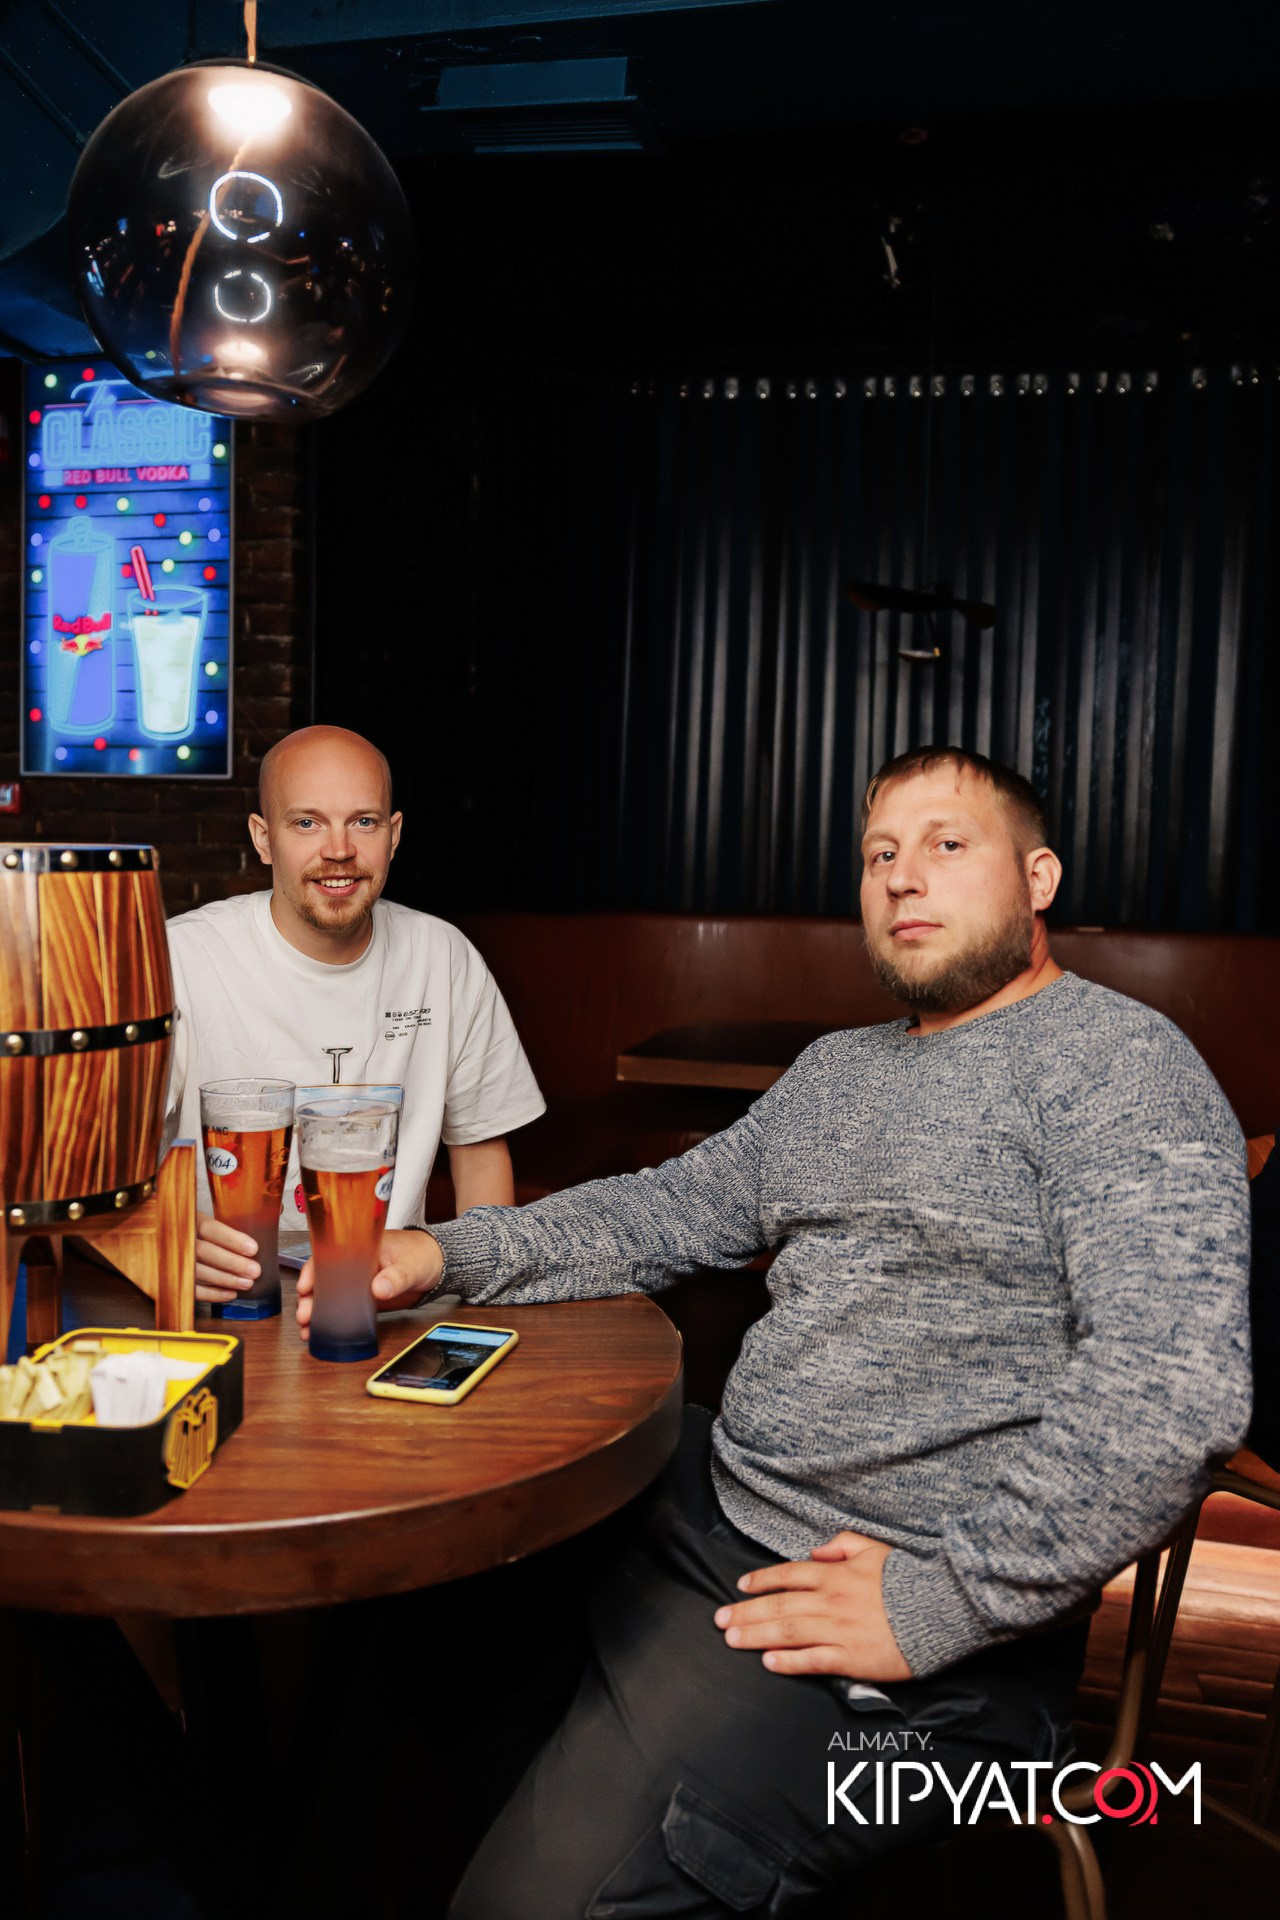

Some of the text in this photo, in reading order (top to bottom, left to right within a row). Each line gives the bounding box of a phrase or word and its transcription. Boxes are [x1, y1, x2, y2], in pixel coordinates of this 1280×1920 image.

[43, 406, 211, 467] CLASSIC
[64, 466, 189, 485] RED BULL VODKA
